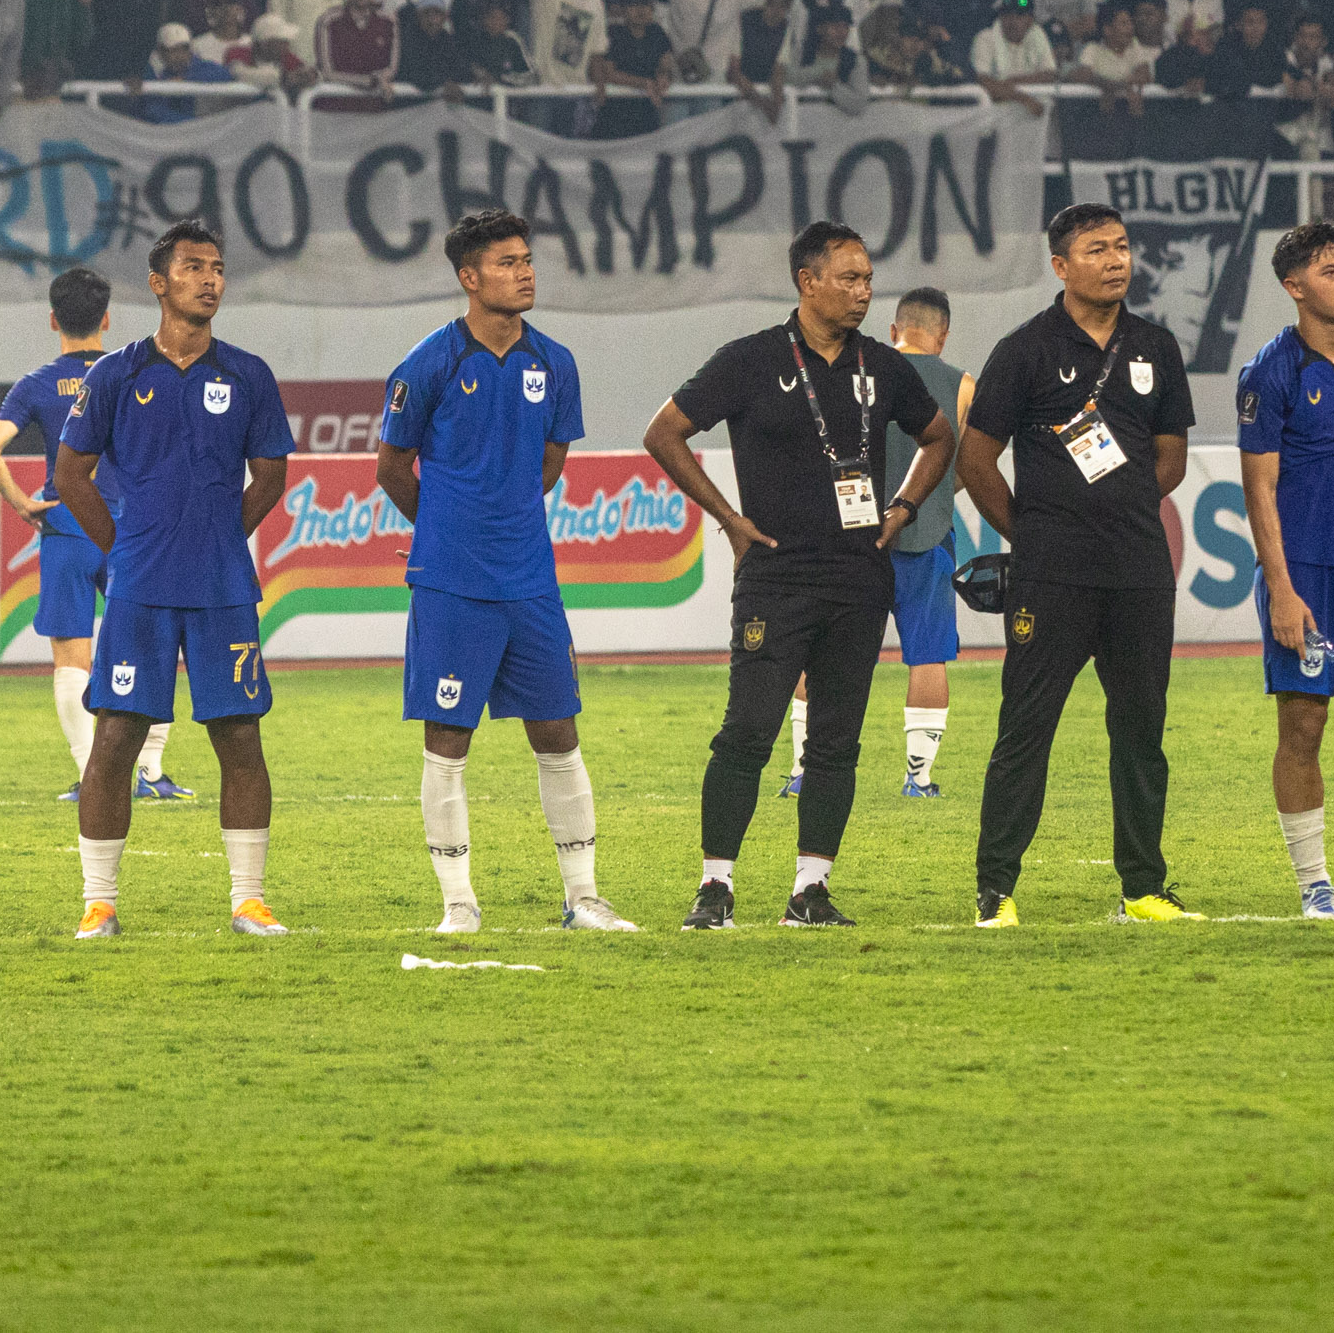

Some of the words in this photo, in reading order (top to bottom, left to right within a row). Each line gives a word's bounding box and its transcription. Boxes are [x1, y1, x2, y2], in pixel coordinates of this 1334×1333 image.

[343, 129, 999, 277] CHAMPION
[1105, 161, 1251, 215] HLGN
[229, 641, 261, 683] 77
